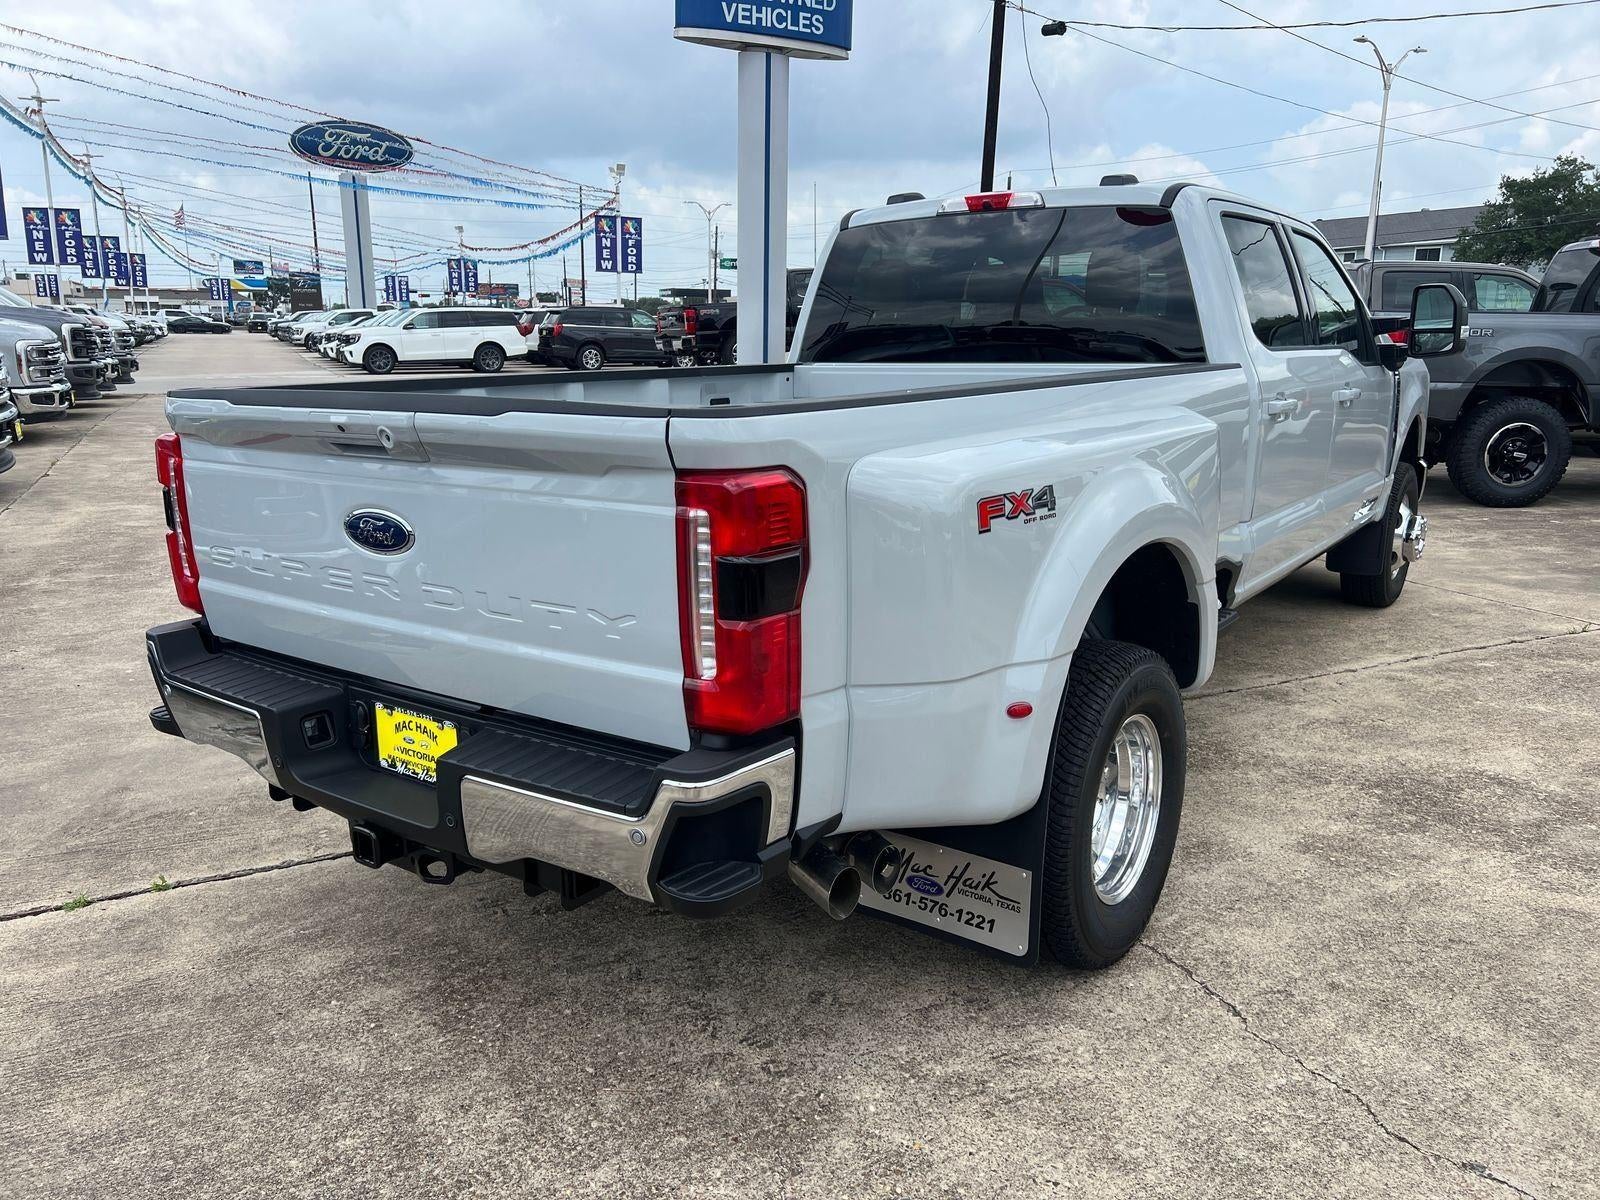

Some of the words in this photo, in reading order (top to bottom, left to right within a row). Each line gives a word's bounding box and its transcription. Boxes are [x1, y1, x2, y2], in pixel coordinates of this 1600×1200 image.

[721, 2, 824, 35] VEHICLES
[318, 129, 387, 161] Ford
[32, 230, 48, 263] NEW
[64, 231, 78, 264] FORD
[601, 238, 612, 270] NEW
[627, 240, 637, 271] FORD
[85, 252, 96, 276] NEW
[107, 253, 118, 277] FORD
[452, 271, 460, 291] NEW
[468, 272, 476, 291] FORD
[977, 485, 1056, 535] FX4
[1023, 516, 1038, 525] OFF
[1039, 512, 1057, 521] ROAD
[357, 517, 395, 545] Ford
[209, 545, 402, 601] SUPER
[421, 583, 637, 639] DUTY
[395, 720, 413, 734] MAC
[416, 721, 438, 746] HAIK
[898, 848, 939, 884] Mac
[943, 861, 1021, 899] Haik
[911, 876, 939, 894] Ford
[996, 900, 1022, 914] TEXAS
